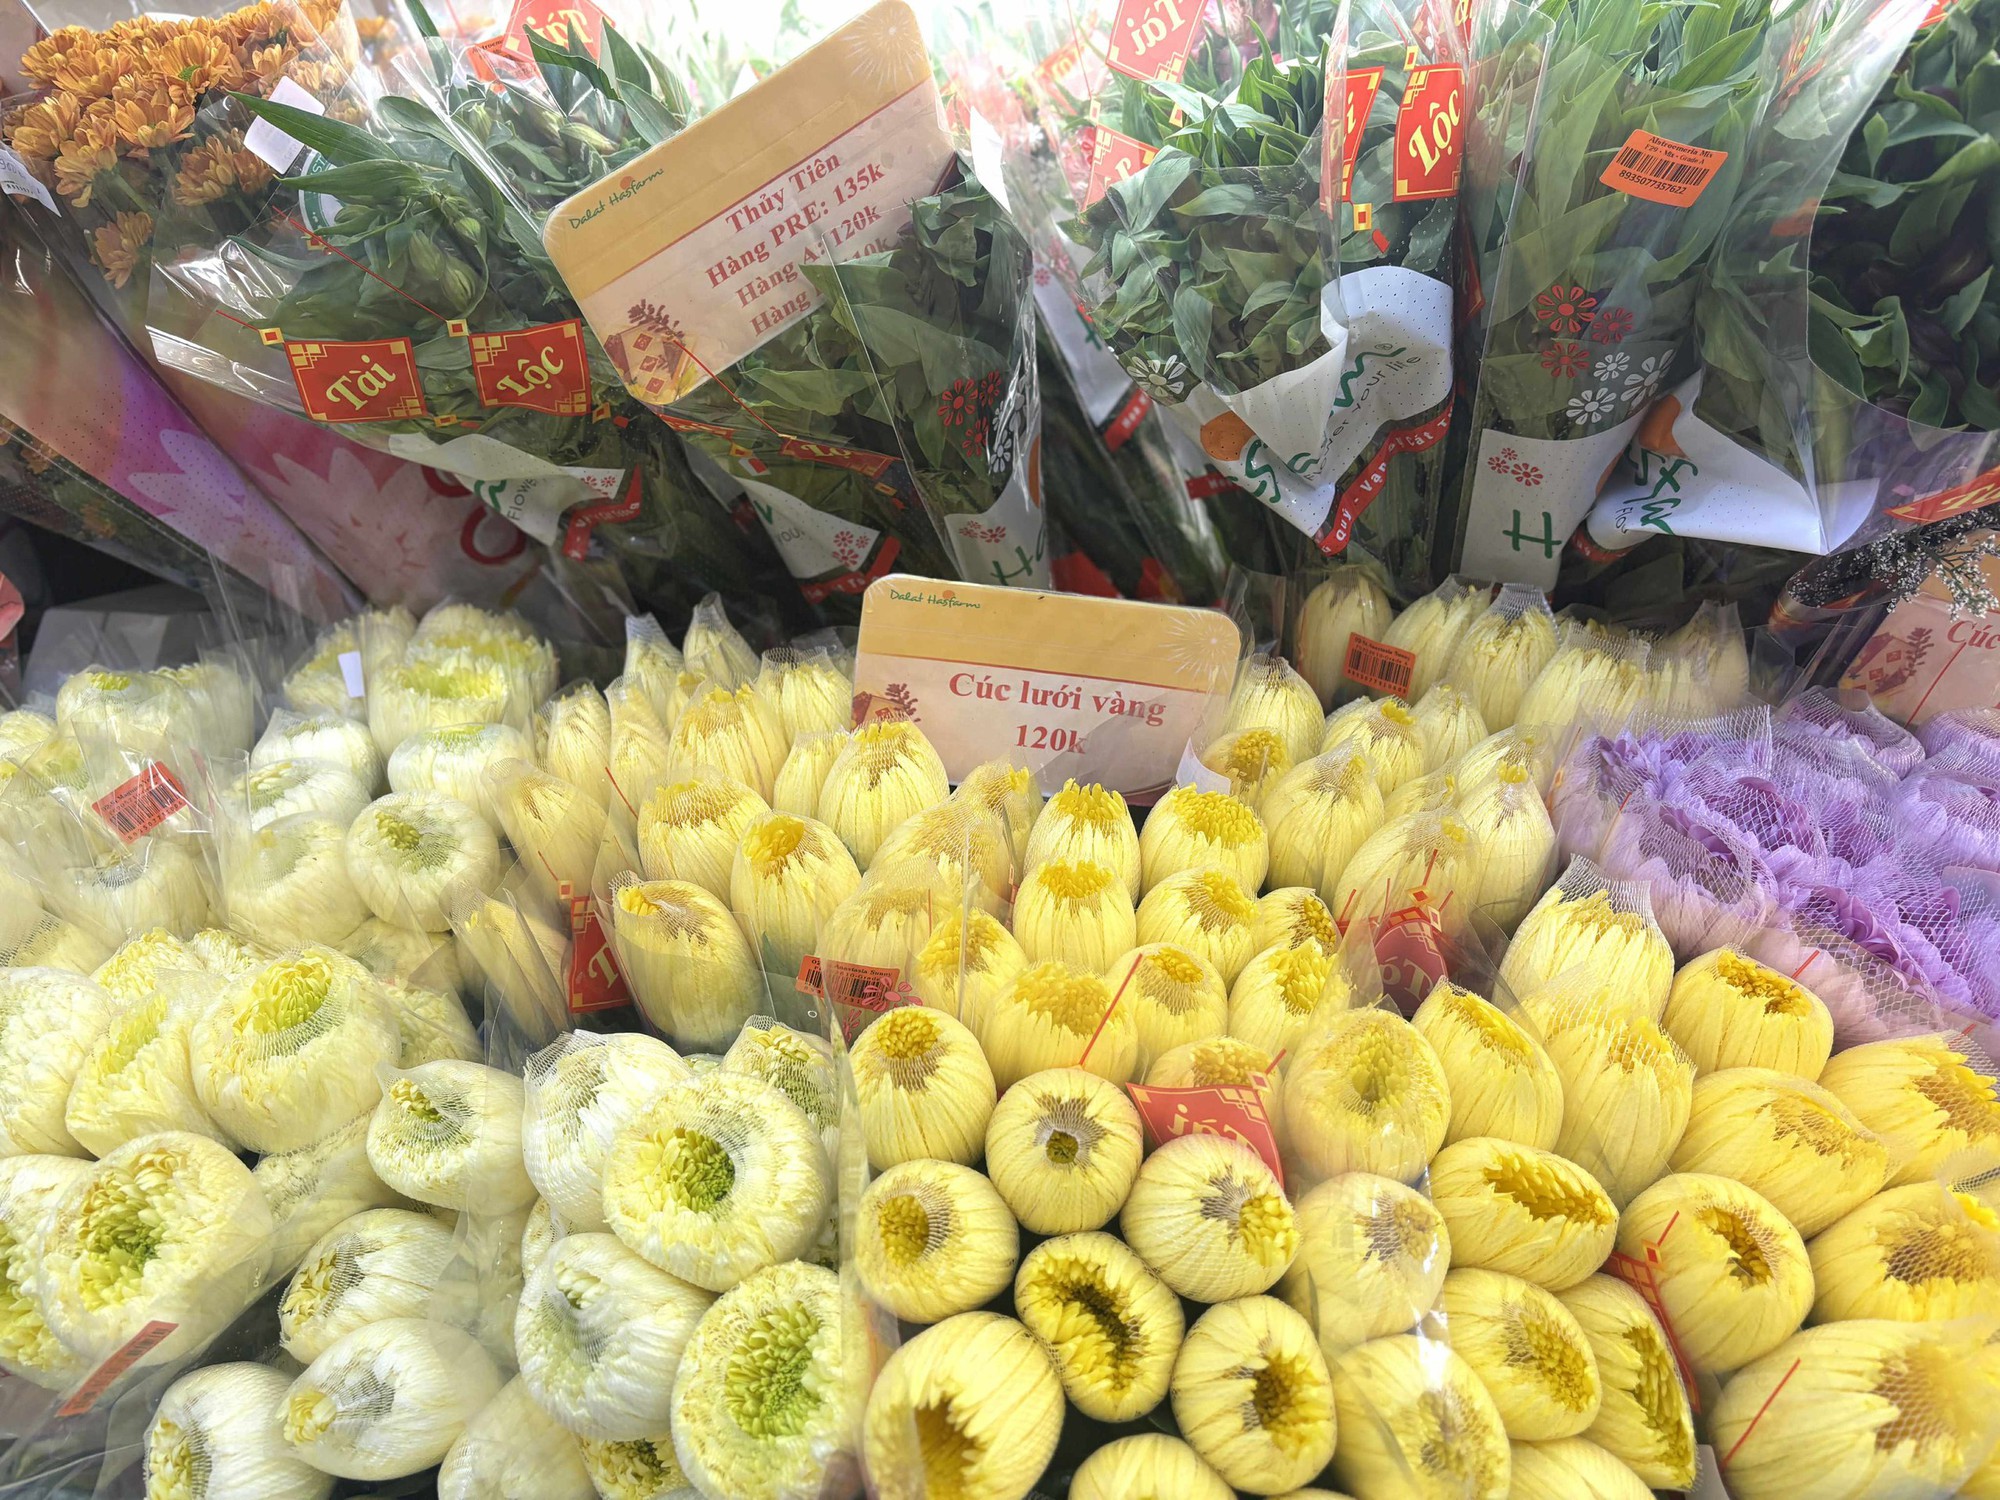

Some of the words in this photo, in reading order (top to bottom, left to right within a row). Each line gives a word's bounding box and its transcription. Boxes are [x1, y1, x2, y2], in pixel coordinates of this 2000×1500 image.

[1408, 89, 1461, 177] Lộc
[1648, 136, 1699, 155] Alstroemeria
[1699, 149, 1713, 158] Mix
[1664, 150, 1675, 158] Mix
[1680, 155, 1698, 163] Grade
[568, 200, 606, 229] Dalat
[608, 168, 664, 205] Hasfarm
[725, 188, 785, 233] Thủy
[788, 154, 841, 193] Tiên
[1619, 169, 1687, 195] 8935077357622
[704, 241, 771, 288] Hàng
[769, 201, 829, 248] PRE:
[832, 163, 886, 206] 135k
[735, 261, 799, 308] Hàng
[802, 242, 827, 265] A:
[830, 205, 882, 247] 120k
[749, 291, 811, 337] Hàng
[325, 354, 397, 411] Tài
[495, 343, 565, 398] Lộc
[890, 589, 924, 602] Dalat
[927, 593, 981, 609] Hasfarm
[949, 672, 1011, 702] Cúc
[1019, 680, 1083, 711] lưới
[1092, 691, 1167, 727] vàng
[1015, 724, 1088, 755] 120k
